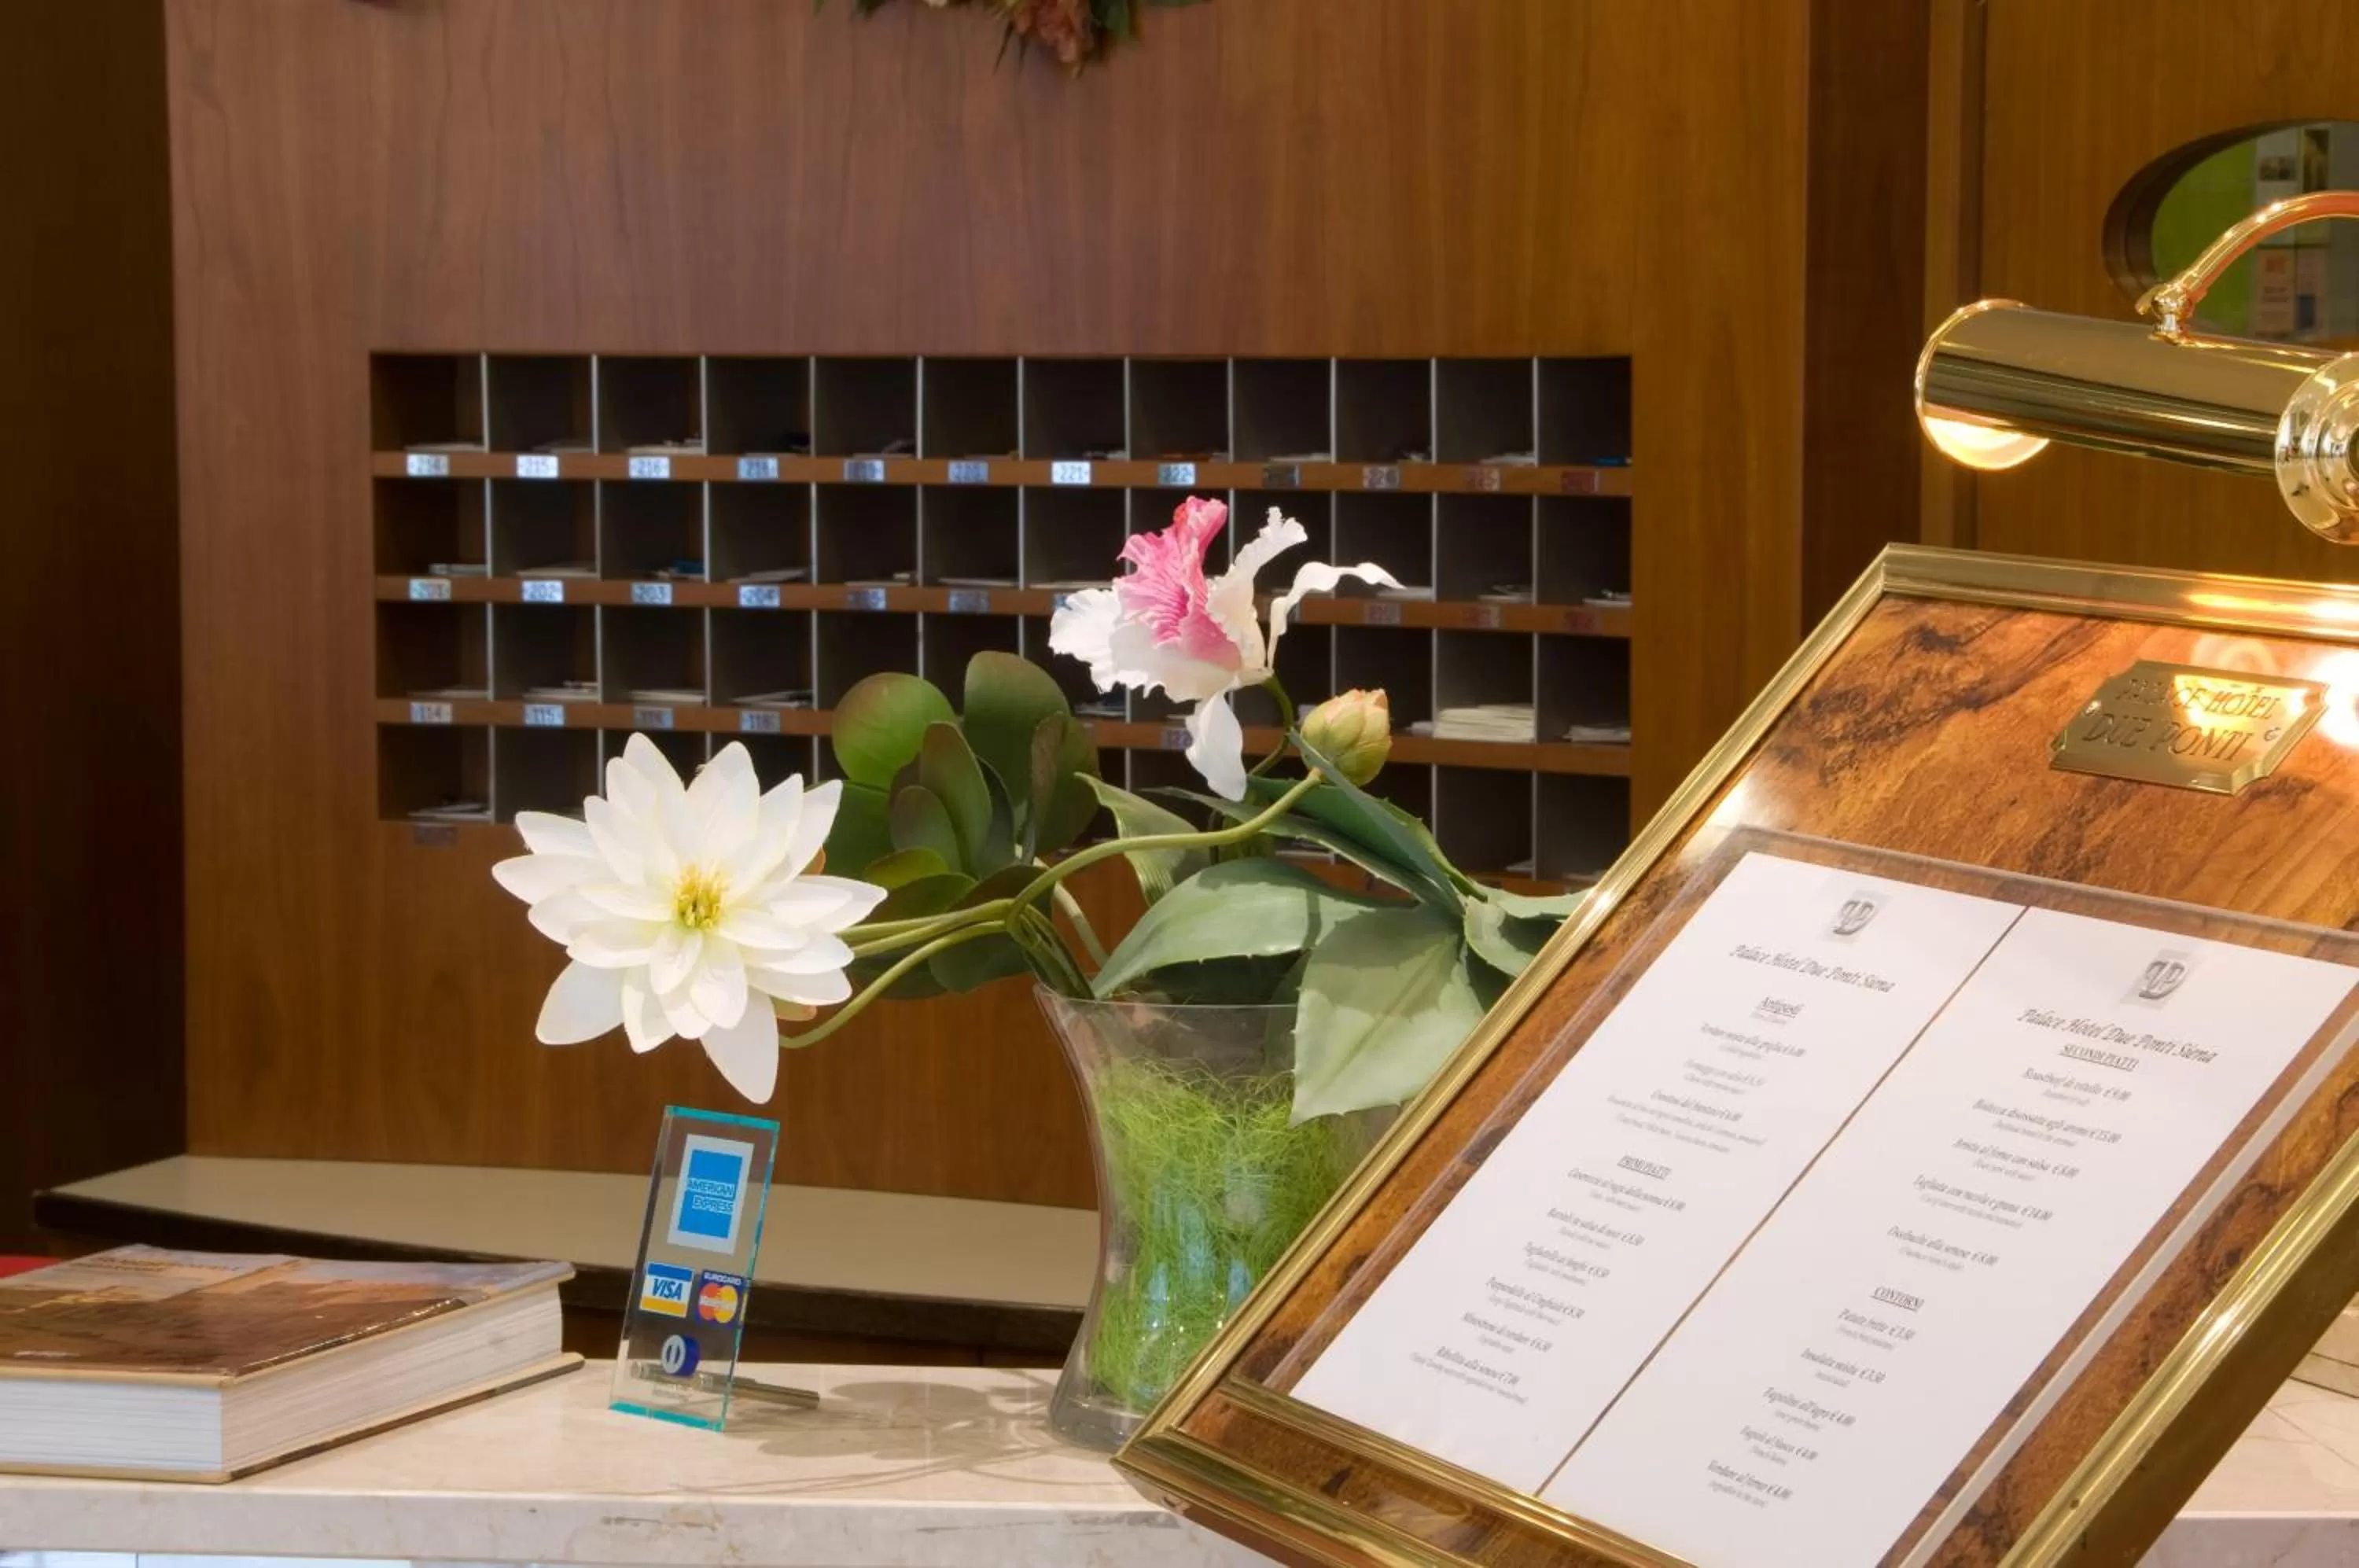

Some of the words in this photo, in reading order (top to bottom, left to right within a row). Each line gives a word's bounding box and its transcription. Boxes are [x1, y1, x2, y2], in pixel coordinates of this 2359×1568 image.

[2203, 690, 2281, 720] HOTEL
[2081, 712, 2153, 747] DUE
[2148, 720, 2254, 762] PONTI
[687, 1177, 736, 1198] AMERICAN
[692, 1194, 734, 1215] EXPRESS
[652, 1278, 683, 1301] VISA
